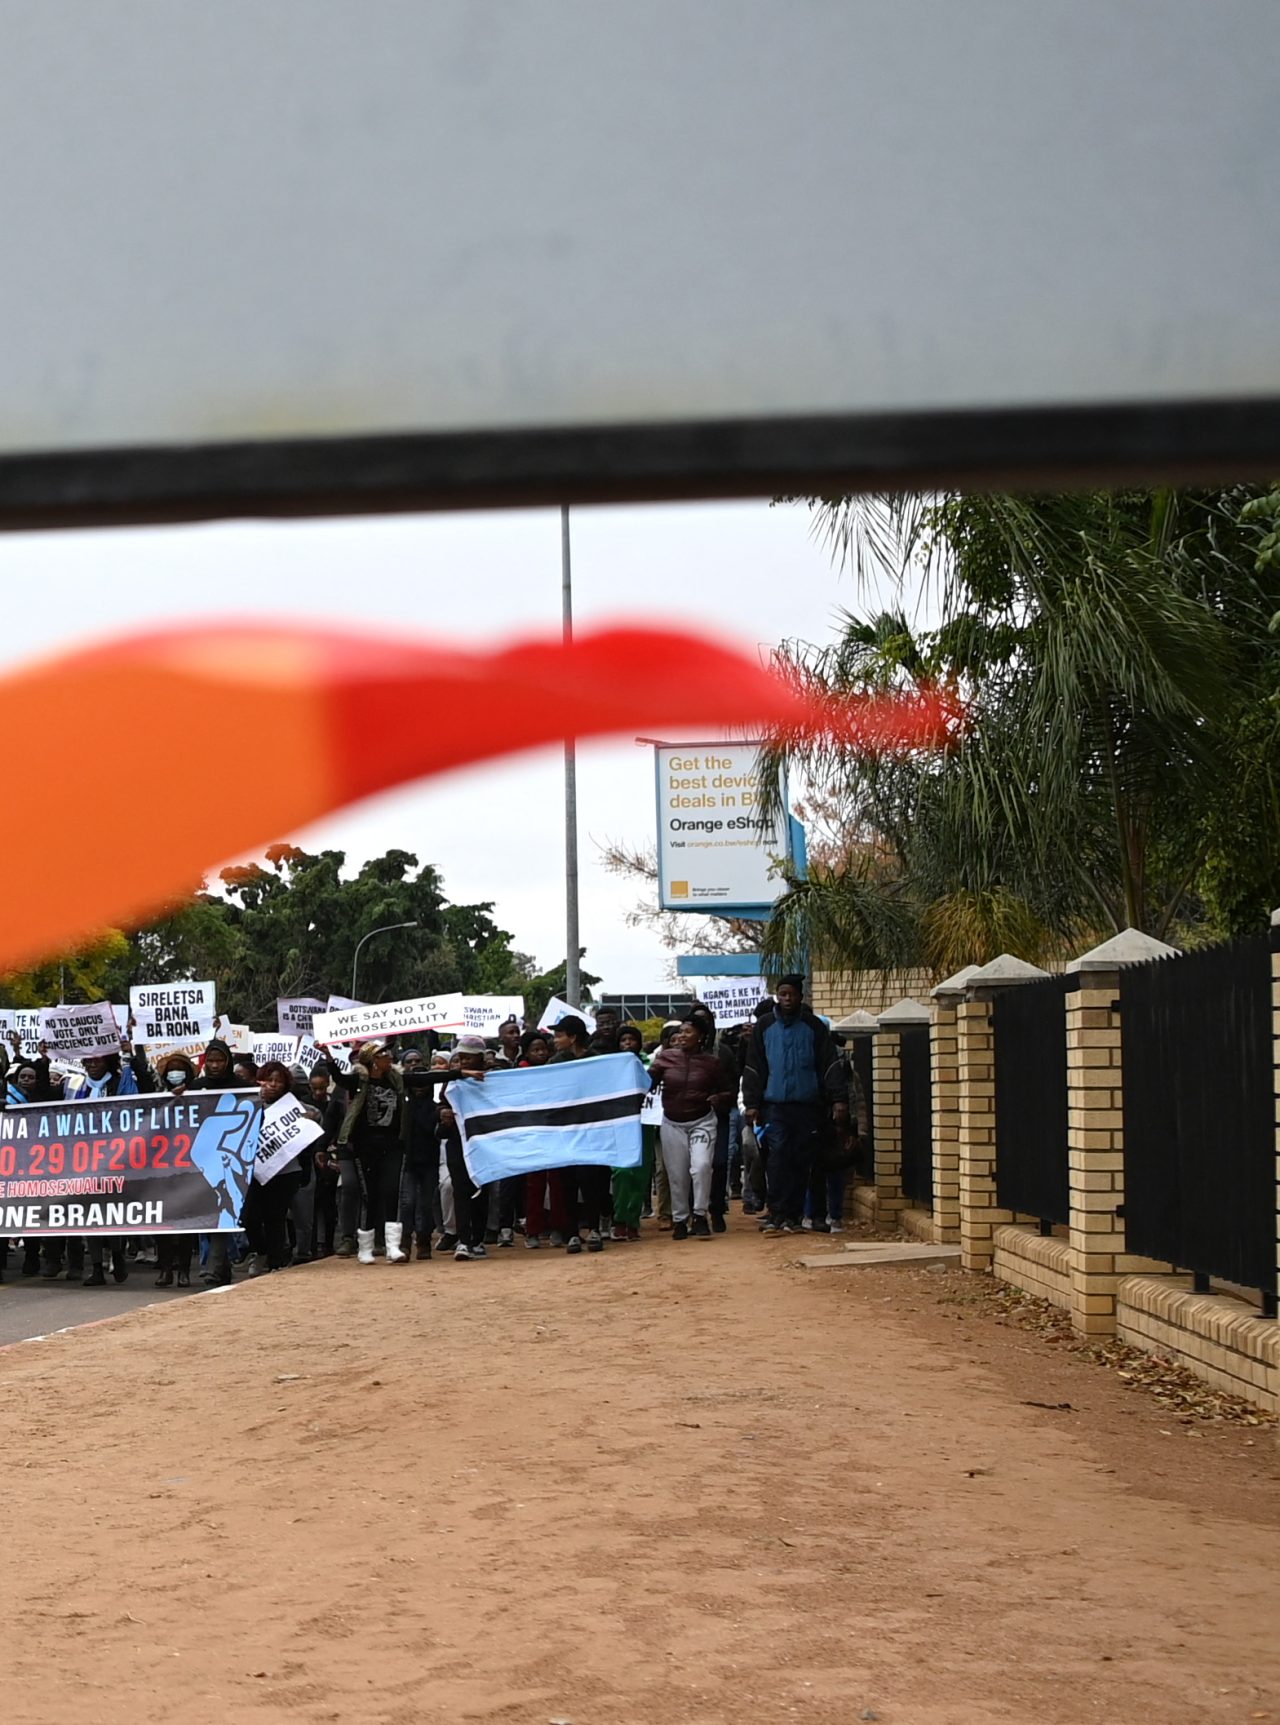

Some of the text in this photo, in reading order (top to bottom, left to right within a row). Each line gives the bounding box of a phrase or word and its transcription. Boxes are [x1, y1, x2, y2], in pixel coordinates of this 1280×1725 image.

[669, 755, 732, 771] Get the
[669, 773, 766, 790] best devic
[669, 793, 716, 808] deals
[721, 793, 736, 807] in
[669, 818, 723, 833] Orange
[138, 989, 204, 1007] SIRELETSA
[703, 986, 761, 1000] KGANG E KE YA
[154, 1006, 189, 1022] BANA
[282, 1013, 290, 1021] IS
[337, 1002, 437, 1025] WE SAY NO TO
[463, 1006, 493, 1014] SWANA
[463, 1013, 501, 1021] HRISTIAN
[45, 1014, 104, 1029] NO TO CAUCUS
[146, 1021, 201, 1038] BA RONA
[329, 1012, 449, 1039] HOMOSEXUALITY
[78, 1026, 99, 1037] ONLY
[95, 1032, 119, 1046] VOTE
[255, 1052, 293, 1064] RRIAGES
[38, 1115, 50, 1138] A
[56, 1110, 113, 1136] WALK
[120, 1106, 145, 1132] OF
[150, 1104, 200, 1130] LIFE
[280, 1107, 302, 1127] OUR
[255, 1124, 301, 1164] FAMILIES
[6, 1176, 126, 1198] HOMOSEXUALITY
[47, 1200, 164, 1228] BRANCH
